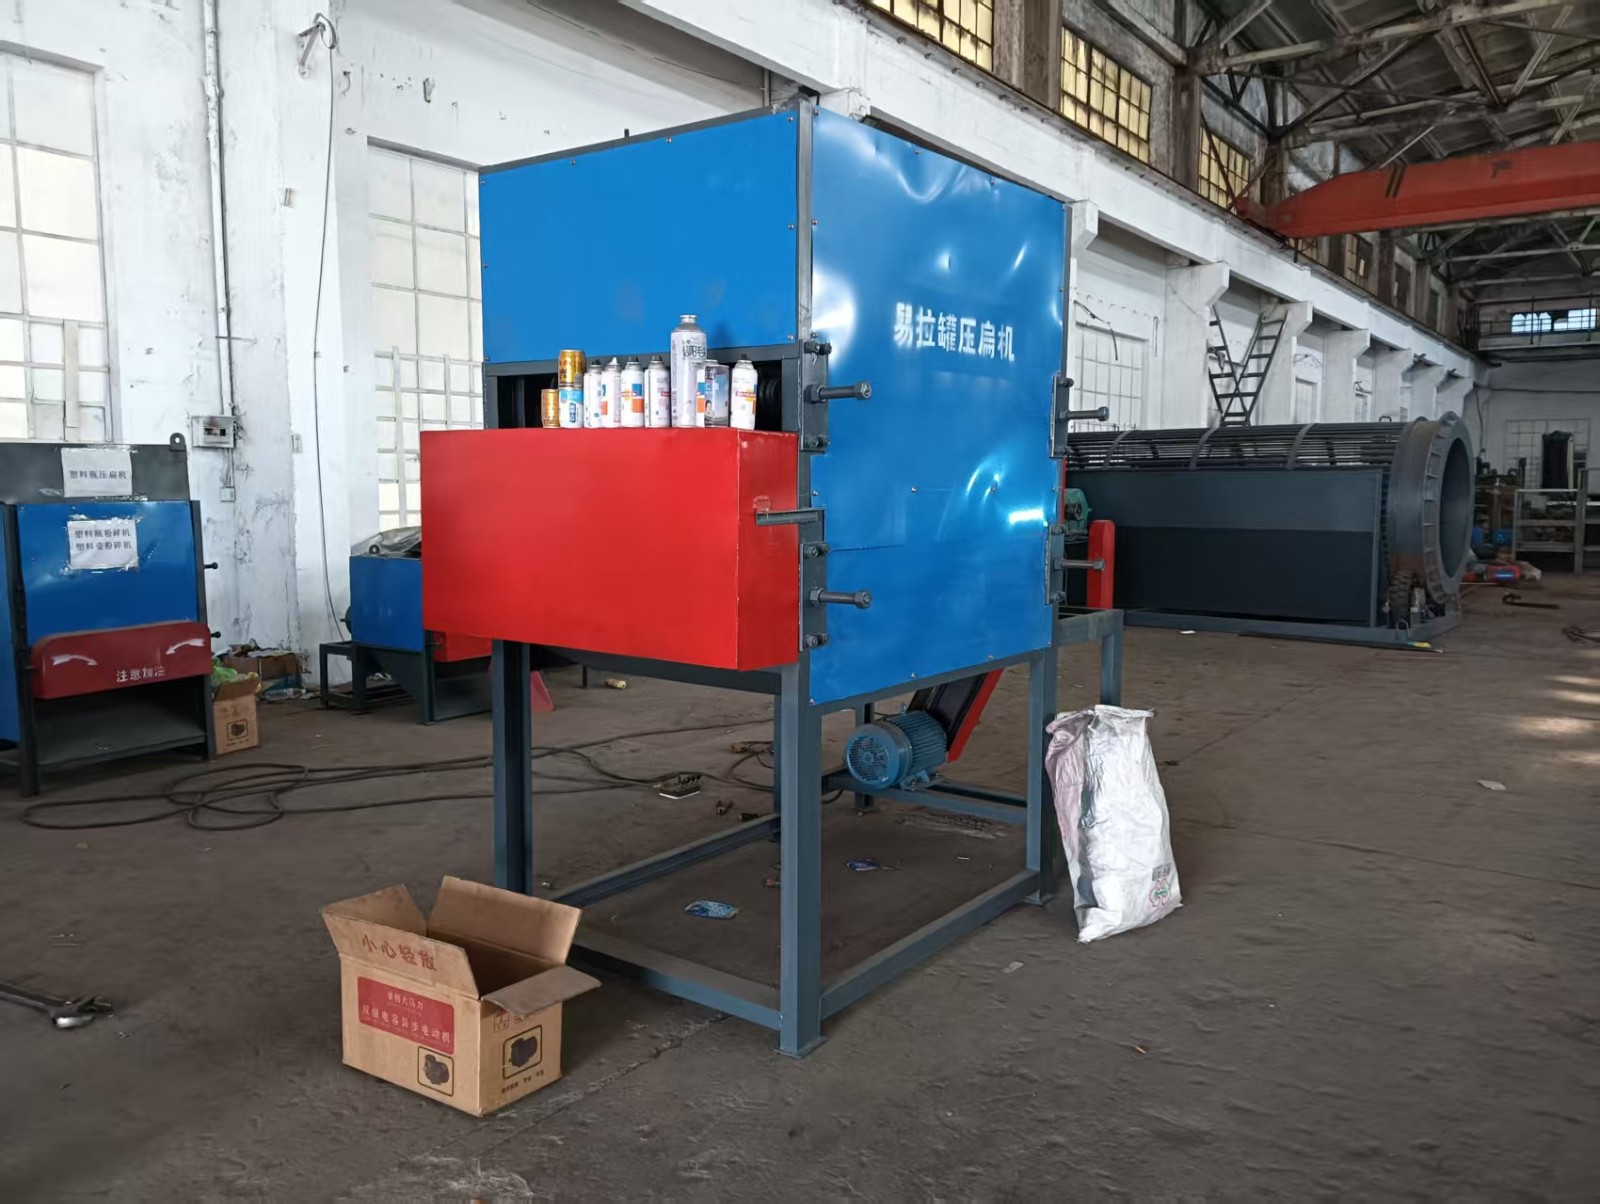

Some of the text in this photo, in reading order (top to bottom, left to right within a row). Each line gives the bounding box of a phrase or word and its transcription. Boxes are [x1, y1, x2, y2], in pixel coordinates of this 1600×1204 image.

[894, 302, 1015, 362] 易拉罐压扁机
[69, 470, 127, 479] 塑料瓶压扁机
[75, 529, 131, 538] 塑料瓶粉碎机
[361, 934, 437, 971] 小心轻放
